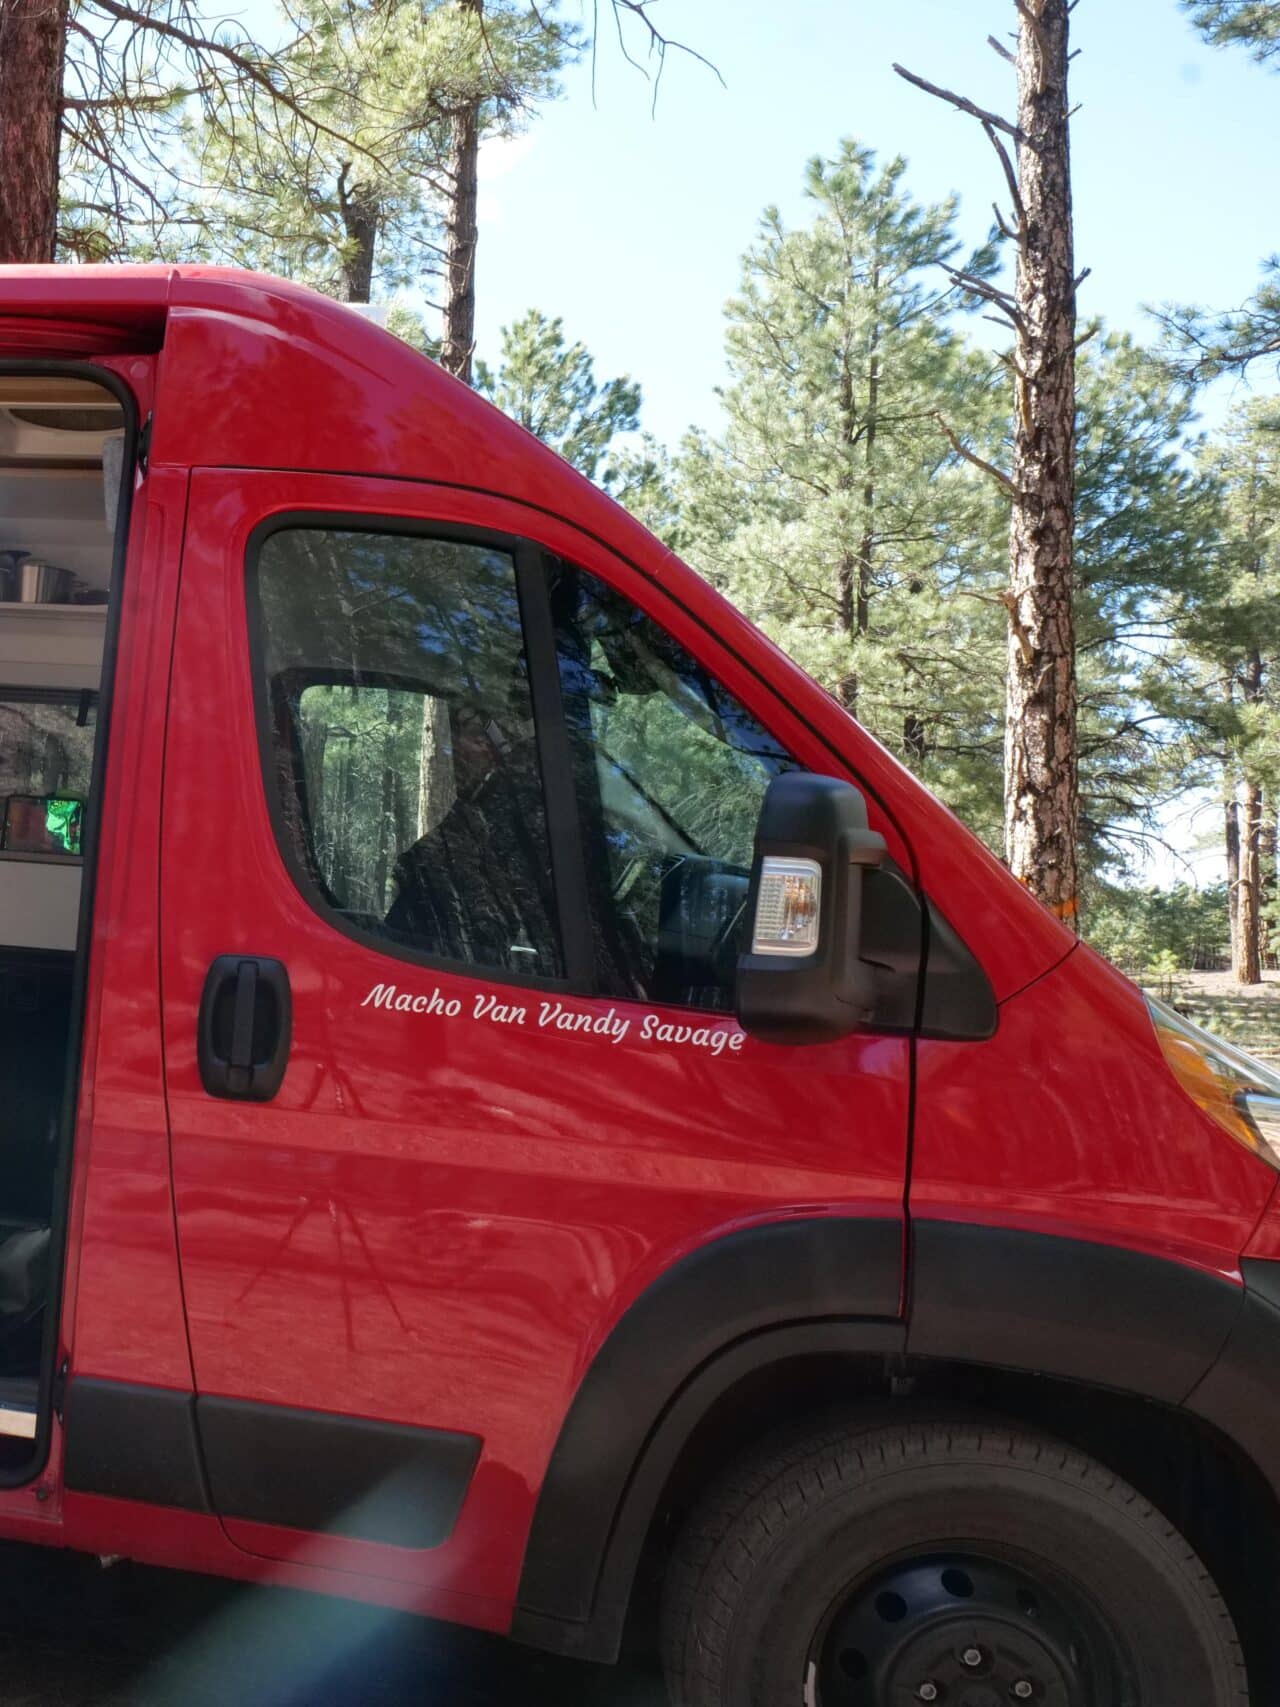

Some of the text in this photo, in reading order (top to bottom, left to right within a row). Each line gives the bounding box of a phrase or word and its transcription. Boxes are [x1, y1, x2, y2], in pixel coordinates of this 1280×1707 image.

[361, 984, 745, 1056] Macho Van Vandy Savage
